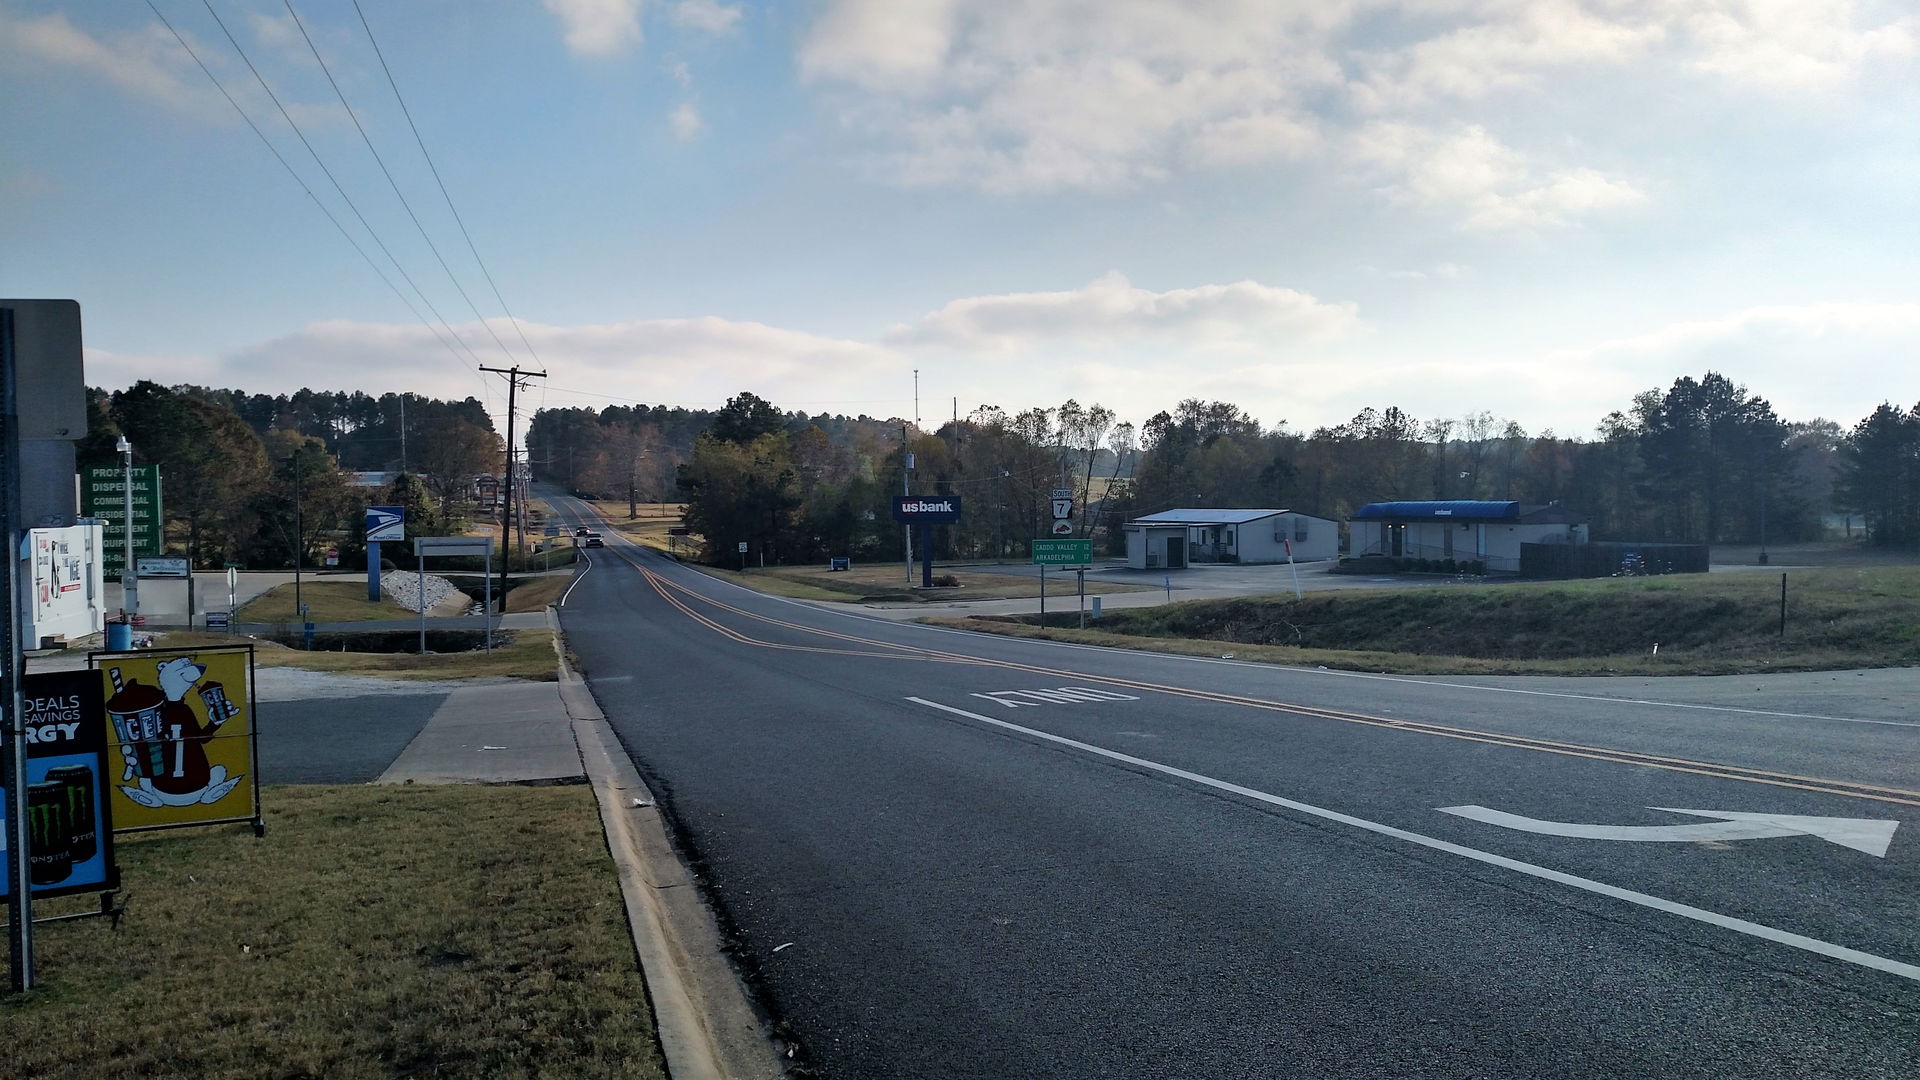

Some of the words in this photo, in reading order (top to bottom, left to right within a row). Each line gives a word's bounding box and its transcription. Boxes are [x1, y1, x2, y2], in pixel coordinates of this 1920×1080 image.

[92, 468, 147, 477] PROPTY
[92, 482, 149, 492] DISPESAL
[1053, 490, 1072, 498] SOUTH
[93, 496, 149, 505] COMMECIAL
[1057, 503, 1065, 514] 7
[94, 510, 149, 519] RESIDETIAL
[103, 539, 148, 548] QUIPENT
[24, 695, 80, 713] DEALS
[25, 709, 80, 724] SAVINGS
[25, 722, 80, 744] RGY
[30, 850, 70, 863] ONSTER
